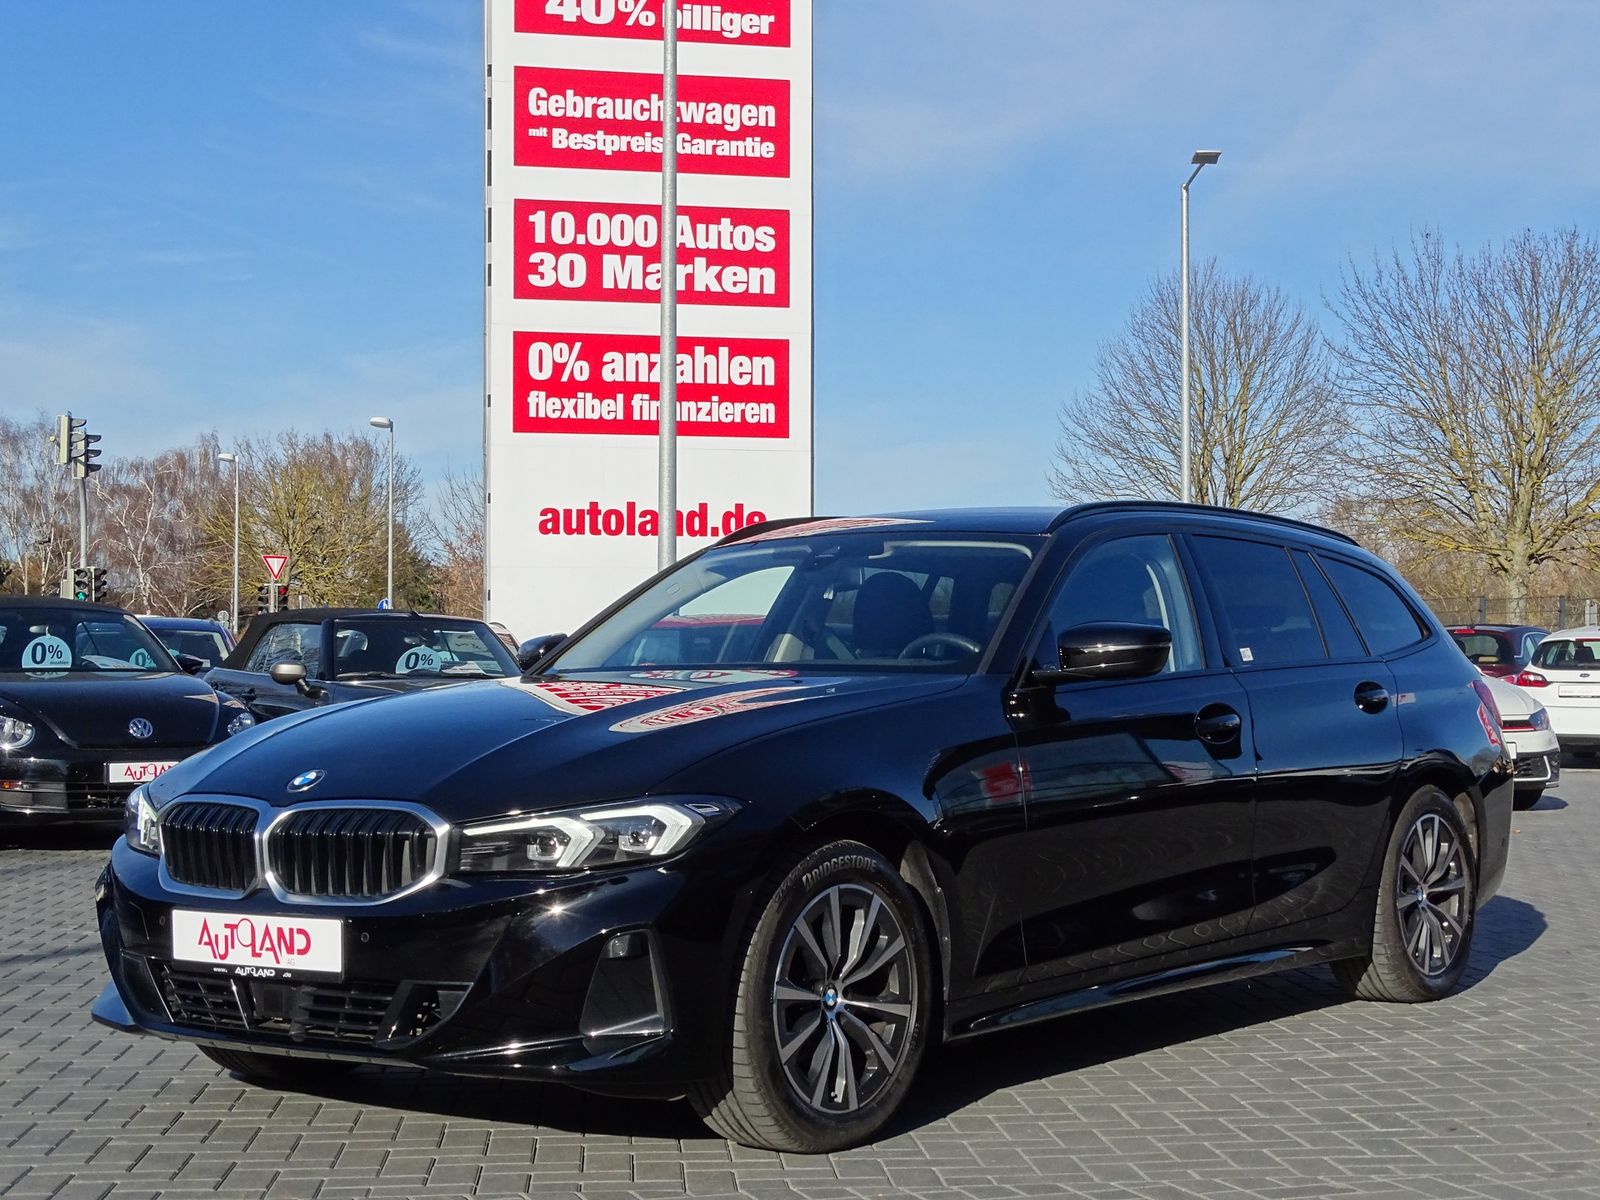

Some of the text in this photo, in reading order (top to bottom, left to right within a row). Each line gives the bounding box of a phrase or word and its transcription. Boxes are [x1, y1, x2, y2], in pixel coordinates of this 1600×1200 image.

[528, 87, 775, 132] Gebrauchwagen
[528, 127, 547, 137] mit
[528, 210, 776, 252] 10.000 Autos
[528, 252, 776, 294] 30 Marken
[528, 341, 590, 382] 0%
[527, 390, 775, 424] flexibel finnzieren
[31, 642, 63, 665] 0%
[405, 652, 434, 670] 0%
[802, 855, 878, 889] BRIDGESTONE
[198, 917, 311, 964] AUTOLAND
